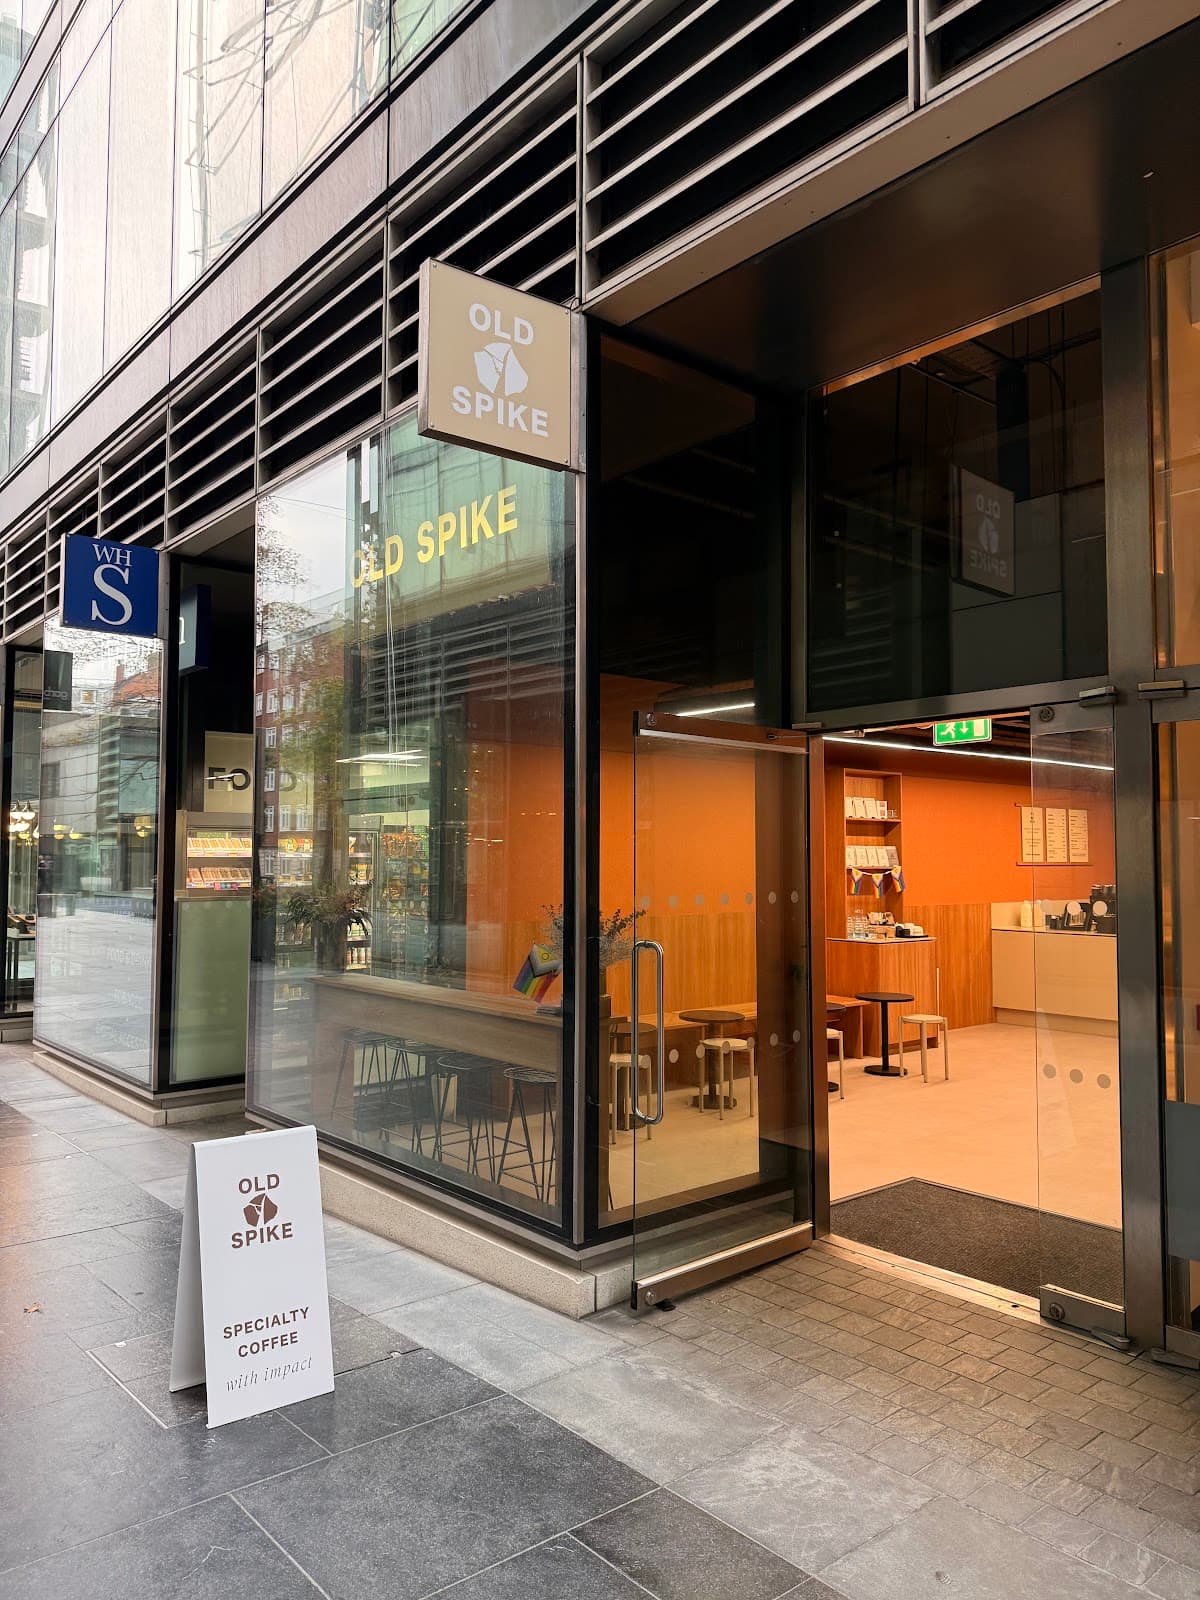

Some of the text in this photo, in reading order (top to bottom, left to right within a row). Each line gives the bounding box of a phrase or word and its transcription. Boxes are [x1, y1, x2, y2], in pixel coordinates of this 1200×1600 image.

[469, 303, 534, 345] OLD
[452, 385, 549, 437] SPIKE
[352, 484, 518, 588] OLD SPIKE
[92, 543, 133, 567] WH
[91, 563, 133, 626] S
[238, 1173, 281, 1194] OLD
[231, 1222, 294, 1250] SPIKE
[223, 1306, 309, 1339] SPECIALTY
[238, 1331, 299, 1358] COFFEE
[226, 1355, 312, 1391] with impact
